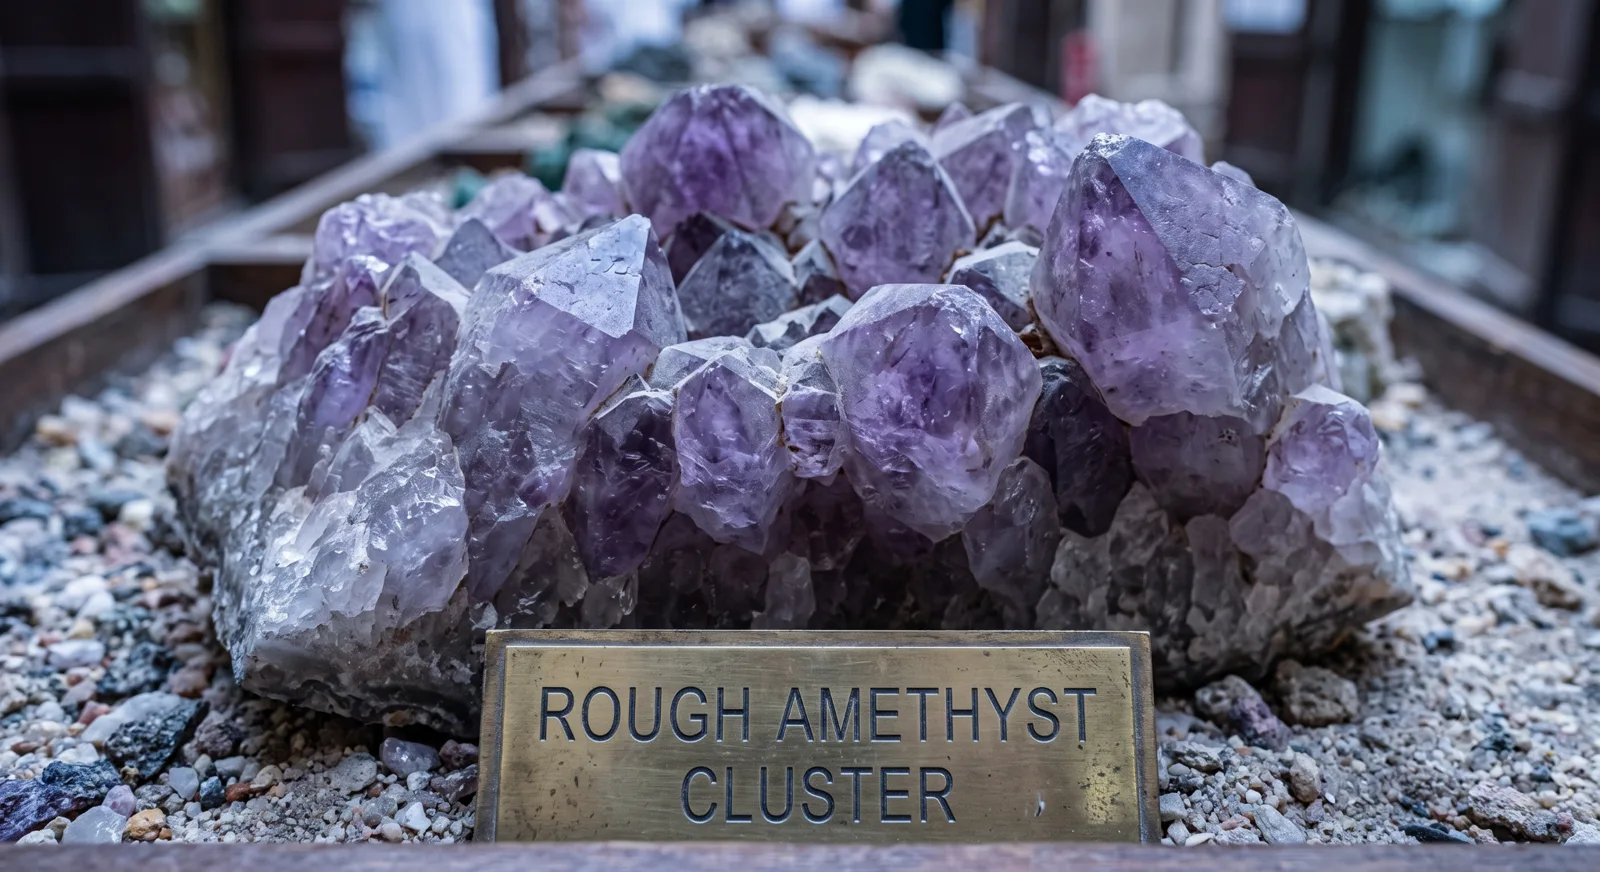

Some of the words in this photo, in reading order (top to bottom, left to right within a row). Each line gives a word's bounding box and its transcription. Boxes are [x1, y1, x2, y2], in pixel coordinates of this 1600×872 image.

[539, 686, 750, 742] ROUGH
[776, 686, 1097, 742] AMETHYST
[681, 766, 957, 824] CLUSTER
